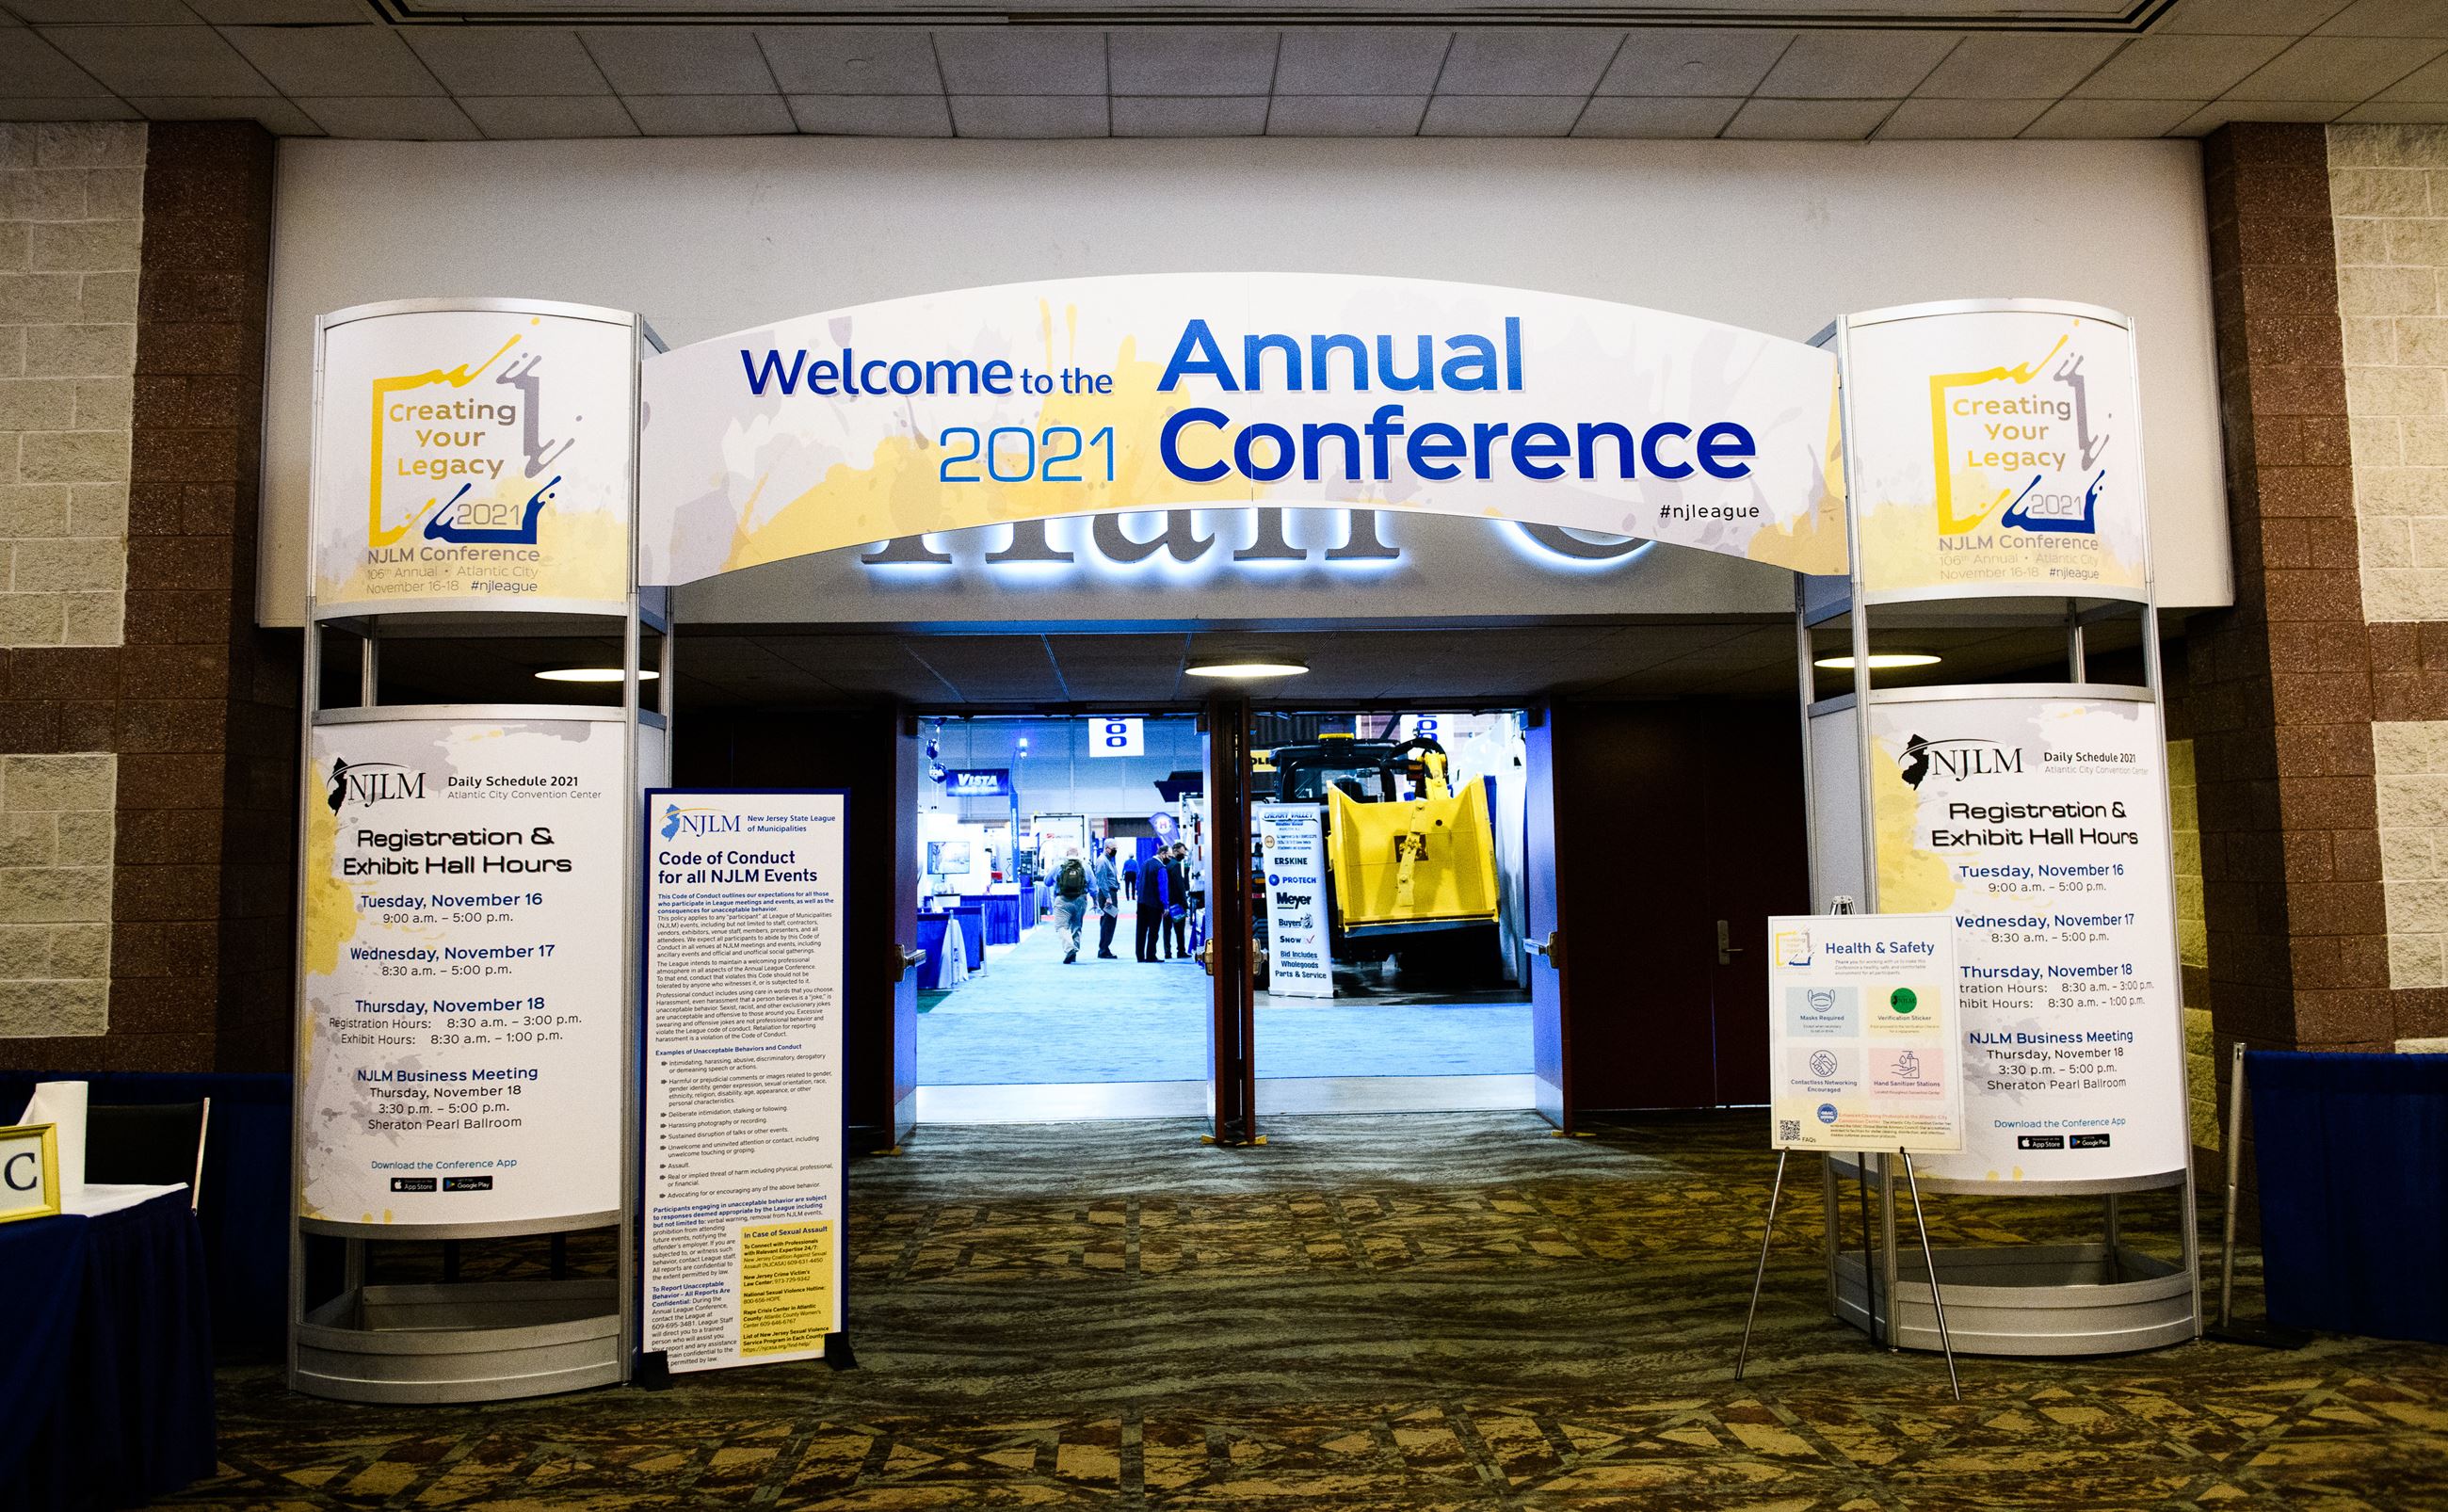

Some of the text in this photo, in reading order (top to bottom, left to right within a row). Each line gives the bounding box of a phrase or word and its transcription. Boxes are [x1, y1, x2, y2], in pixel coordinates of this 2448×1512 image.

[1156, 316, 1523, 393] Annual
[741, 348, 1113, 395] Welcome to the
[389, 398, 516, 426] Creating
[1953, 394, 2070, 420] Creating
[416, 429, 485, 447] Your
[1985, 424, 2049, 441] Your
[1159, 404, 1756, 483] Conference
[941, 426, 1114, 482] 2021
[1969, 450, 2066, 472] Legacy
[397, 458, 504, 480] Legacy
[1660, 504, 1760, 522] #njleague
[2031, 494, 2082, 515] 2021
[457, 504, 520, 524] 2021
[1940, 535, 2099, 552] NJLM Conference
[368, 547, 540, 564] NJLM Conference
[395, 567, 437, 577] Annual
[457, 566, 508, 576] Atlantic
[512, 566, 539, 579] City
[1941, 570, 2007, 579] November
[2050, 568, 2099, 581] #njleague
[366, 581, 538, 594] November 16-18 #njleague
[1105, 718, 1126, 748] 00
[1932, 748, 2023, 781] NJLM
[2044, 752, 2135, 764] Daily Schedule 2021
[348, 772, 426, 808] NJLM
[448, 776, 578, 788] Daily Schedule 2021
[489, 790, 508, 799] City
[1949, 802, 2126, 823] Registration &
[682, 815, 741, 837] NJLM
[358, 828, 555, 851] Registration &
[1932, 828, 2138, 846] Exhibit Hall Hours
[344, 856, 572, 875] Exhibit Hall Hours
[659, 851, 795, 865] Code of Conduct
[658, 869, 817, 883] for all NJLM Events
[1959, 864, 2123, 878] Tuesday, November 16
[362, 893, 542, 909] Tuesday, November 16
[1277, 893, 1311, 909] Meyer
[383, 912, 513, 924] 9:00 a.m. 5:00 p.m.
[1279, 919, 1301, 927] Buyers
[351, 945, 556, 962] Wednesday, November 17
[1826, 941, 1934, 956] Health & Safety
[355, 997, 544, 1015] Thursday, November 18
[1970, 1030, 2133, 1043] NJLM Business Meeting
[358, 1068, 538, 1082] NJLM Business Meeting
[370, 1086, 521, 1099] Thursday, November 18
[368, 1118, 522, 1130] Sheraton Pearl Ballroom
[2062, 1118, 2109, 1127] Conference
[2112, 1118, 2125, 1126] App
[5, 1152, 37, 1191] C
[372, 1161, 415, 1169] Download
[436, 1159, 493, 1168] Conference
[497, 1159, 517, 1167] App
